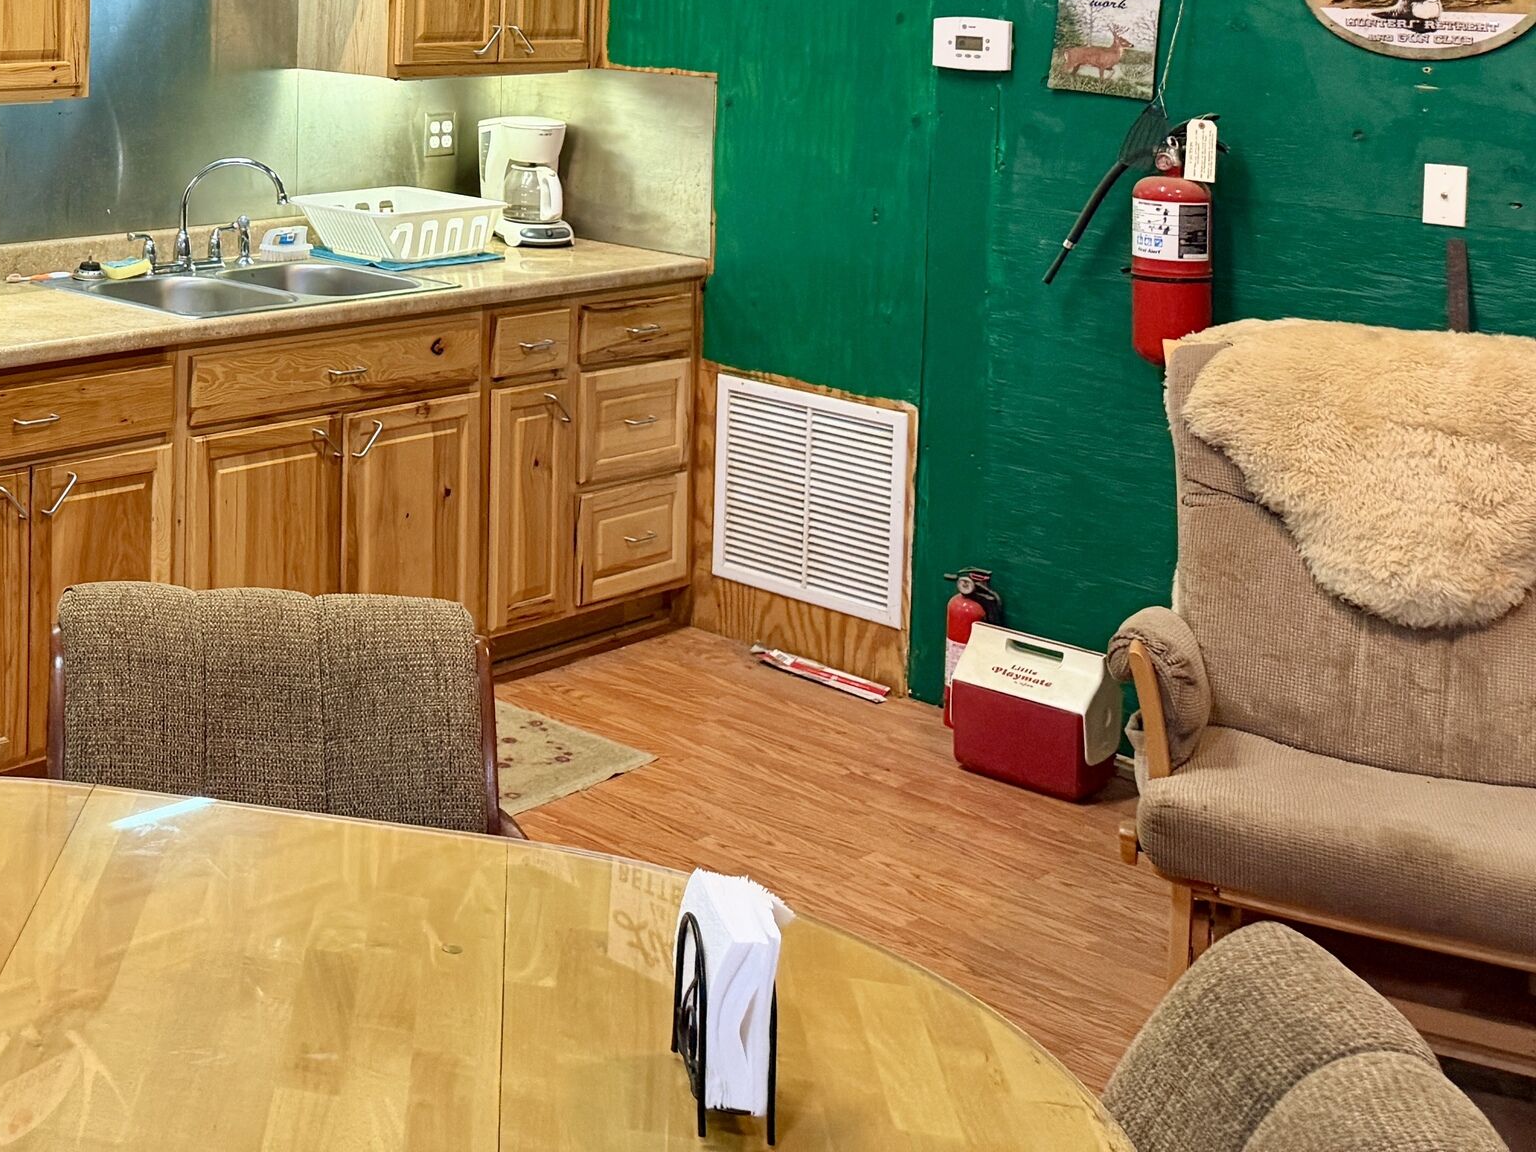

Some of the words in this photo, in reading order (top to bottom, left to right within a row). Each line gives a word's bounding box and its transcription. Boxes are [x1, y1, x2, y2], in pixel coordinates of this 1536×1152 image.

[1424, 19, 1500, 33] RETREAT
[1368, 34, 1394, 42] AND
[1397, 33, 1431, 44] GUN
[1433, 34, 1474, 45] CLUB
[991, 666, 1053, 687] Playmate
[1011, 664, 1038, 676] Little
